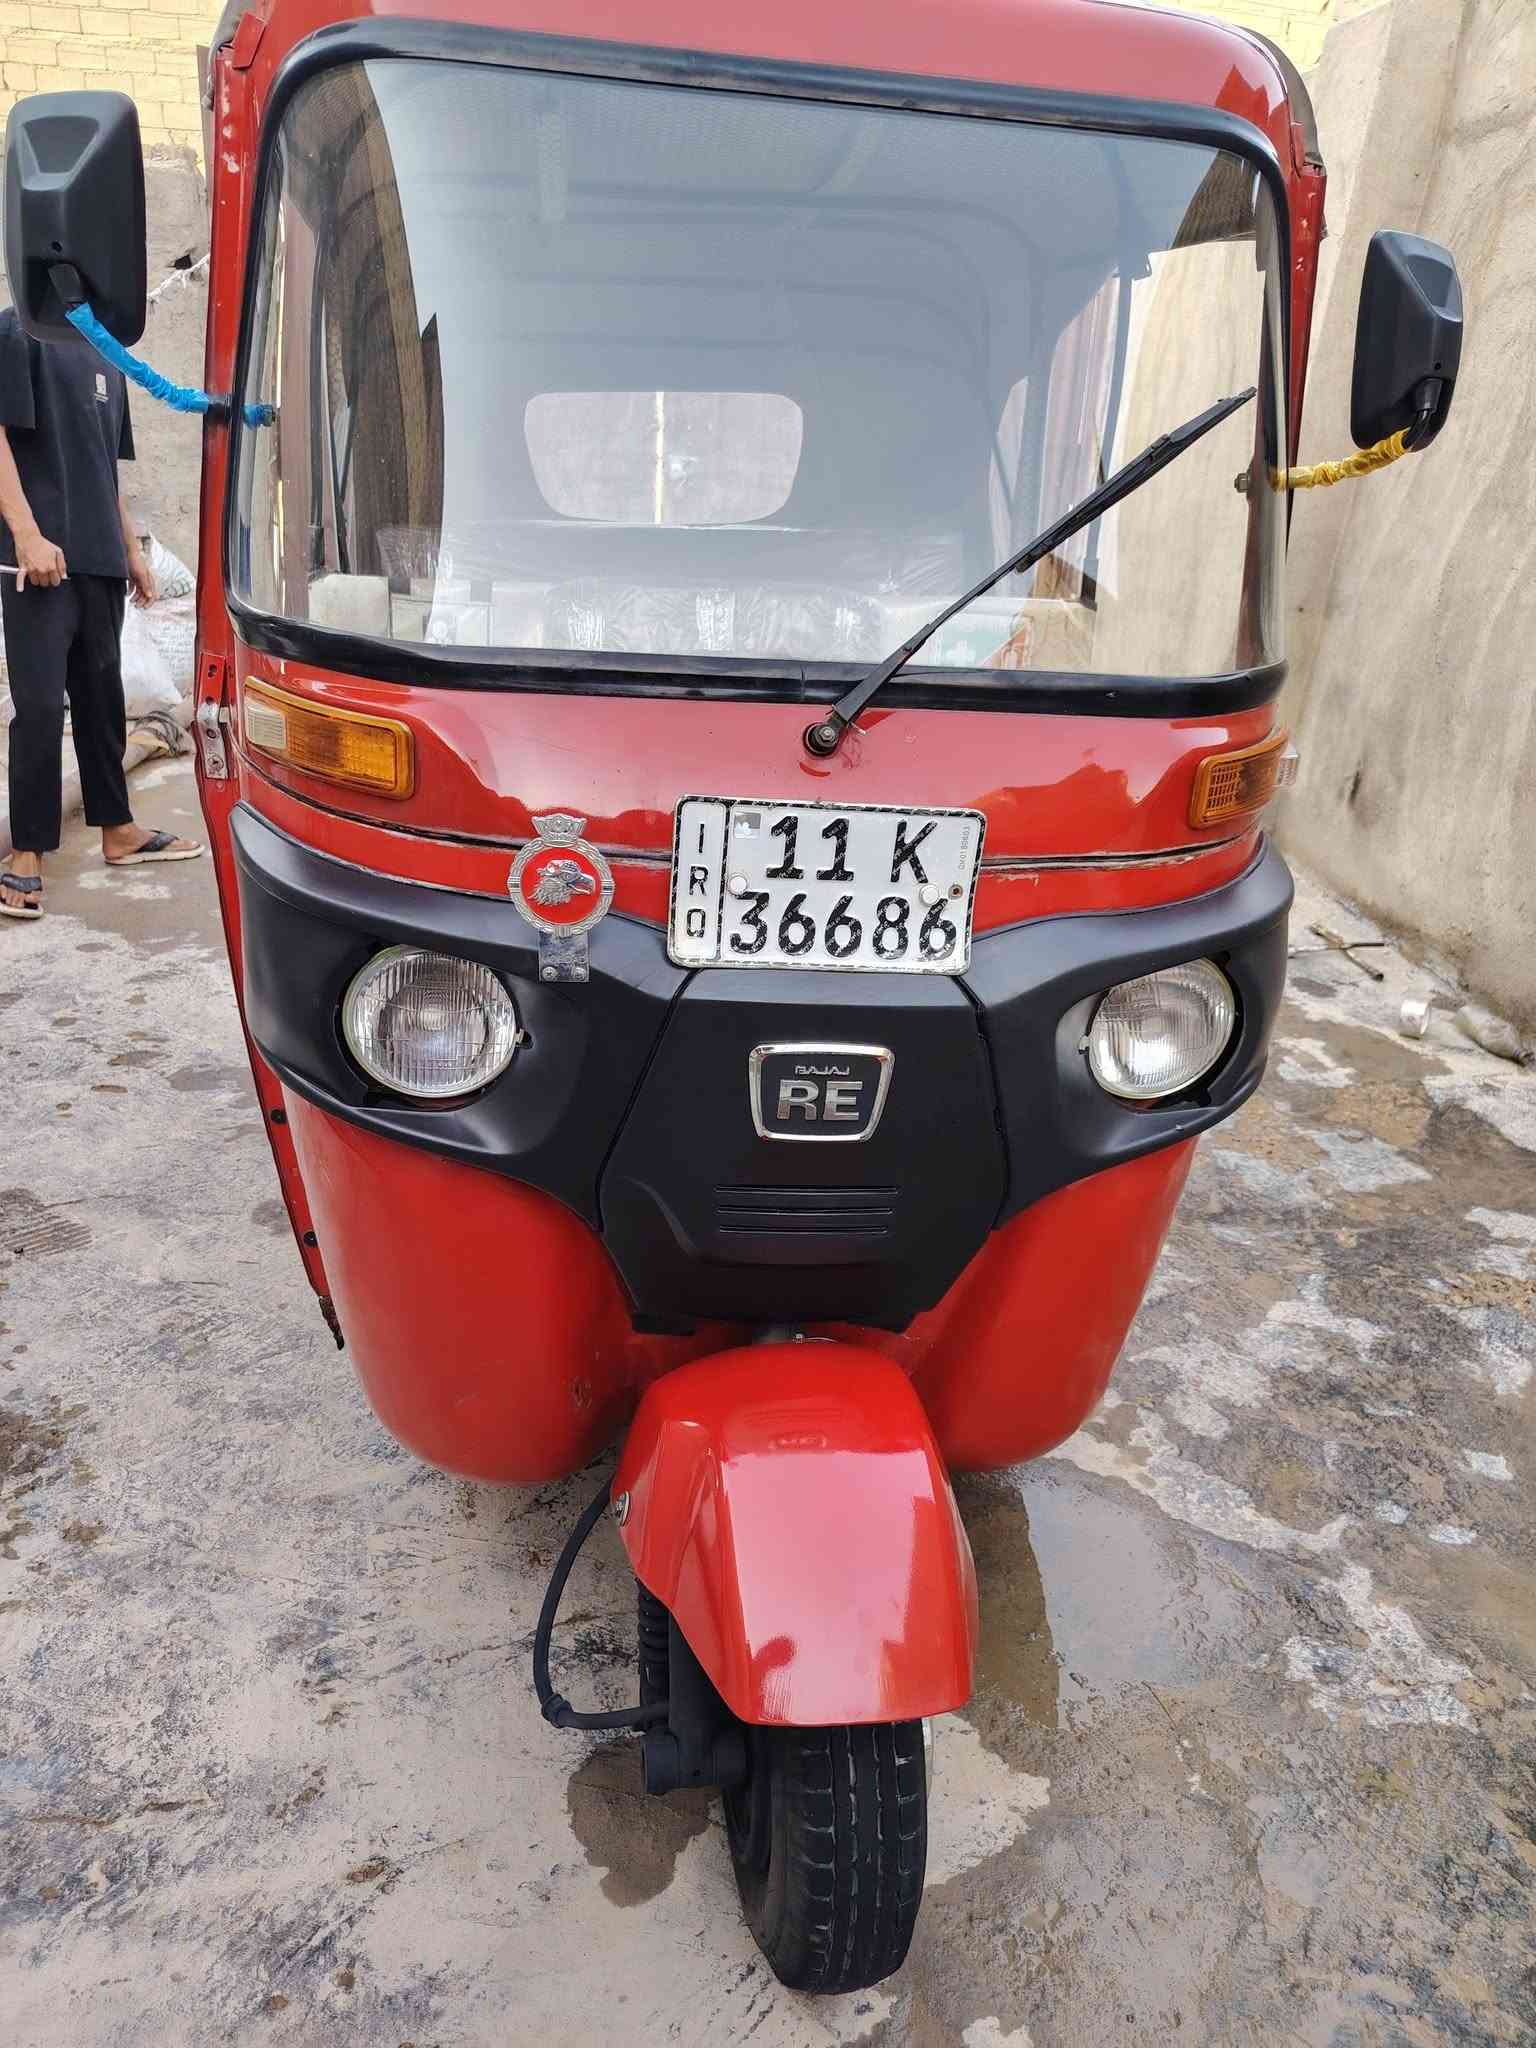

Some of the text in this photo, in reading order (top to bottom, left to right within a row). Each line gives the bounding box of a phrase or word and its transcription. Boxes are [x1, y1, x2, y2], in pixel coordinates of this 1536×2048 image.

[766, 815, 855, 881] 11
[890, 819, 938, 884] K
[730, 891, 957, 961] 36686
[794, 1064, 851, 1076] BAJAJ
[776, 1079, 864, 1121] RE
